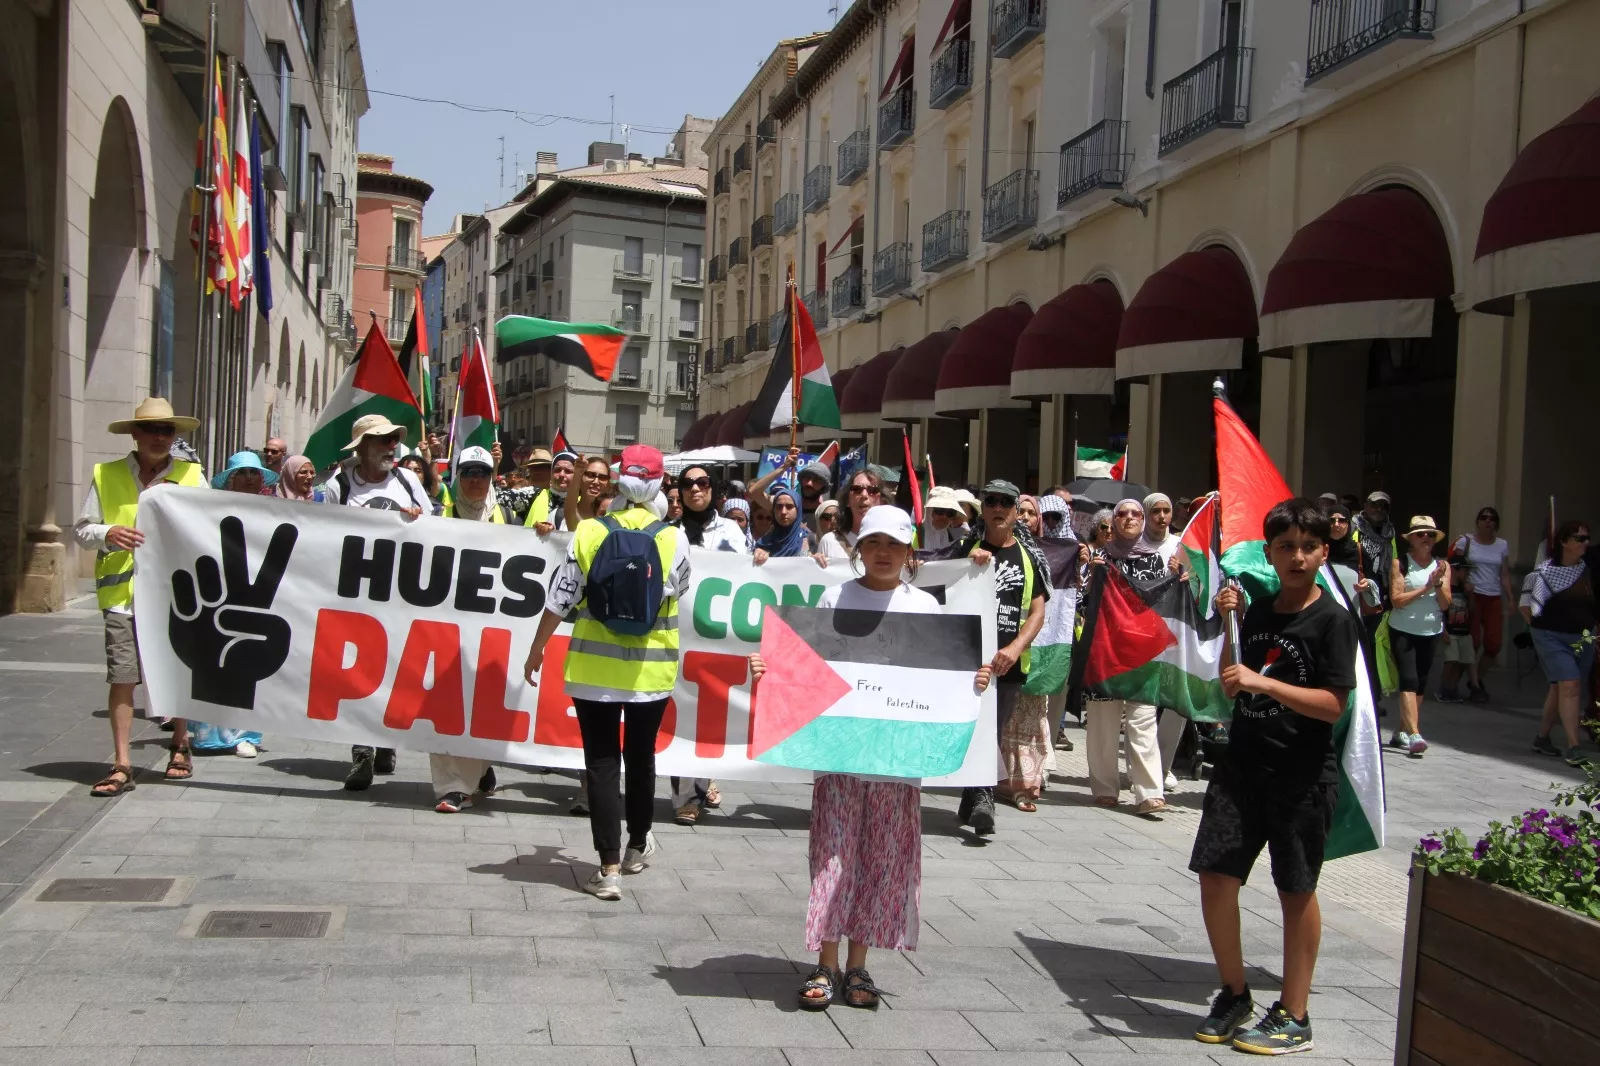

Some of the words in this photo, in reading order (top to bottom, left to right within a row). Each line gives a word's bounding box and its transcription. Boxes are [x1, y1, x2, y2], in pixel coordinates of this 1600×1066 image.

[686, 345, 697, 401] HOSTAL
[338, 535, 576, 623] HUES
[1248, 633, 1269, 644] FREE
[1274, 634, 1307, 682] PALESTINE
[857, 679, 883, 692] Free
[886, 696, 930, 711] Palestina
